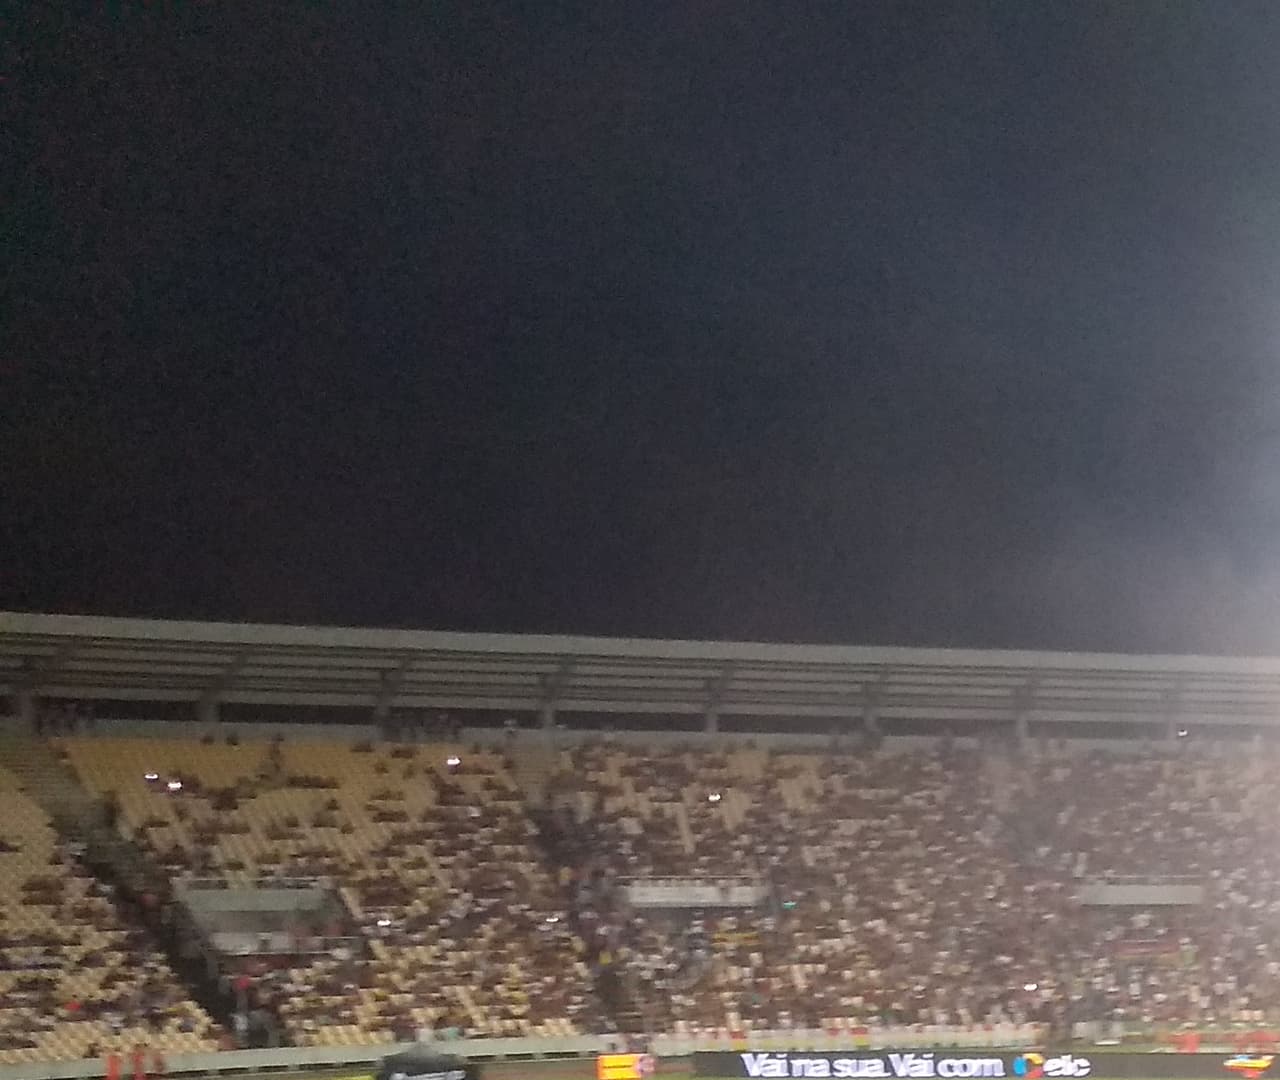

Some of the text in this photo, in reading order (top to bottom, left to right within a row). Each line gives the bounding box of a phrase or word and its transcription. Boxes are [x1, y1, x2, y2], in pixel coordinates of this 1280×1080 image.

[741, 1053, 789, 1077] Vai
[791, 1057, 830, 1077] na
[888, 1053, 935, 1077] Vai
[937, 1057, 1005, 1077] com
